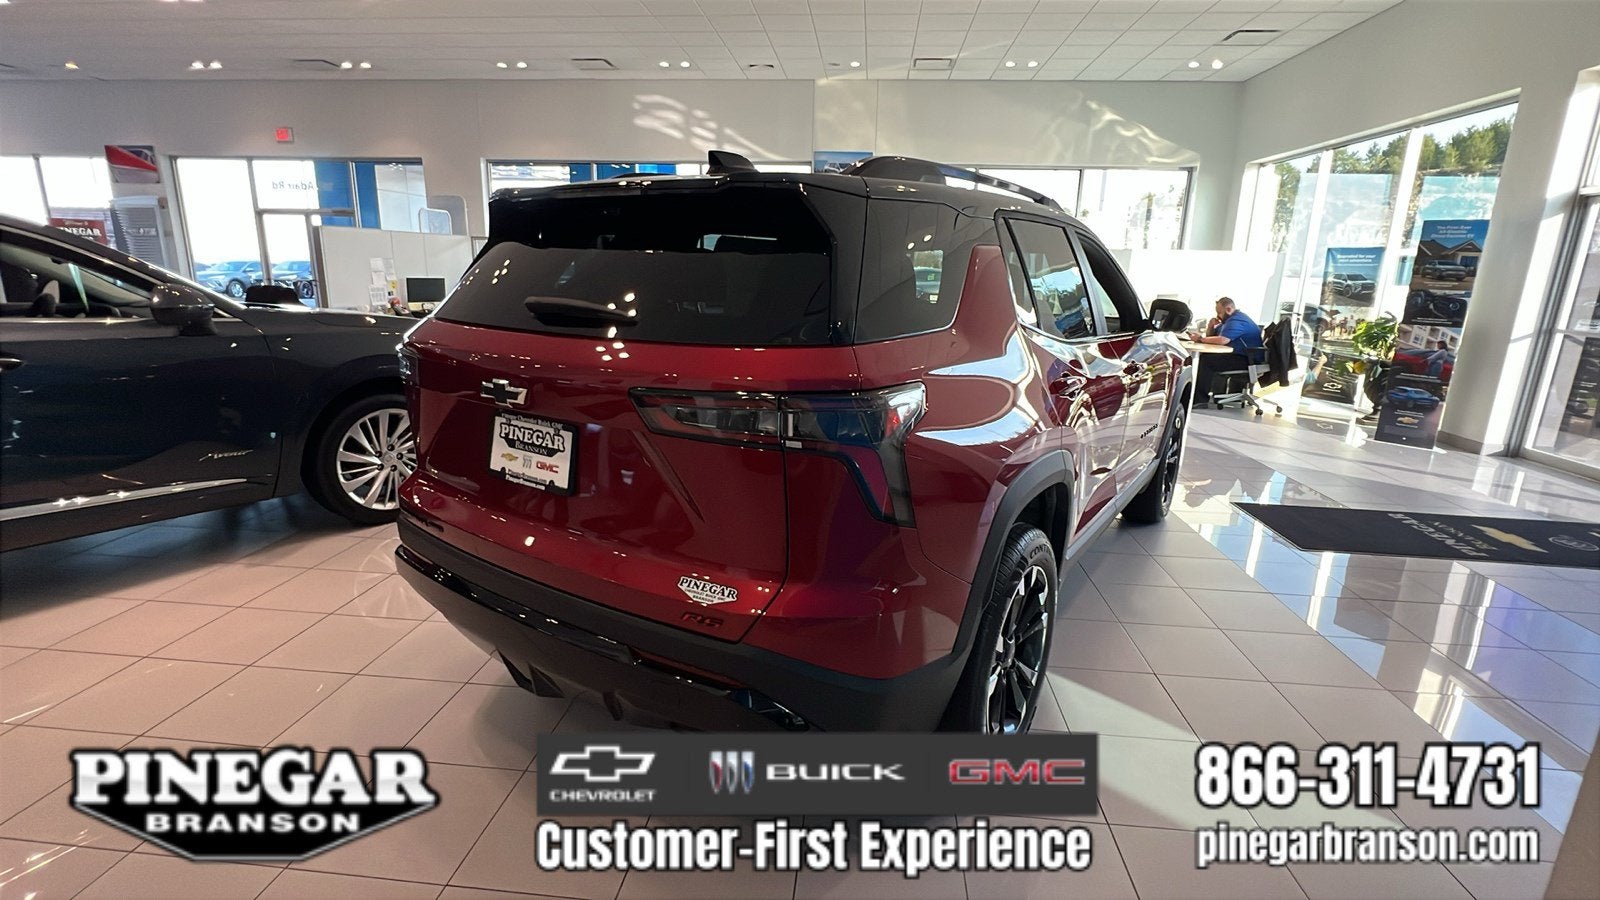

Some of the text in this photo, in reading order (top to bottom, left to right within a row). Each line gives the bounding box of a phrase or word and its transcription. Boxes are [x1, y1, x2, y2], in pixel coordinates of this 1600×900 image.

[500, 423, 565, 451] PINEGAR
[536, 460, 559, 474] GMC
[679, 577, 736, 600] PINEGAR
[681, 611, 724, 627] RS
